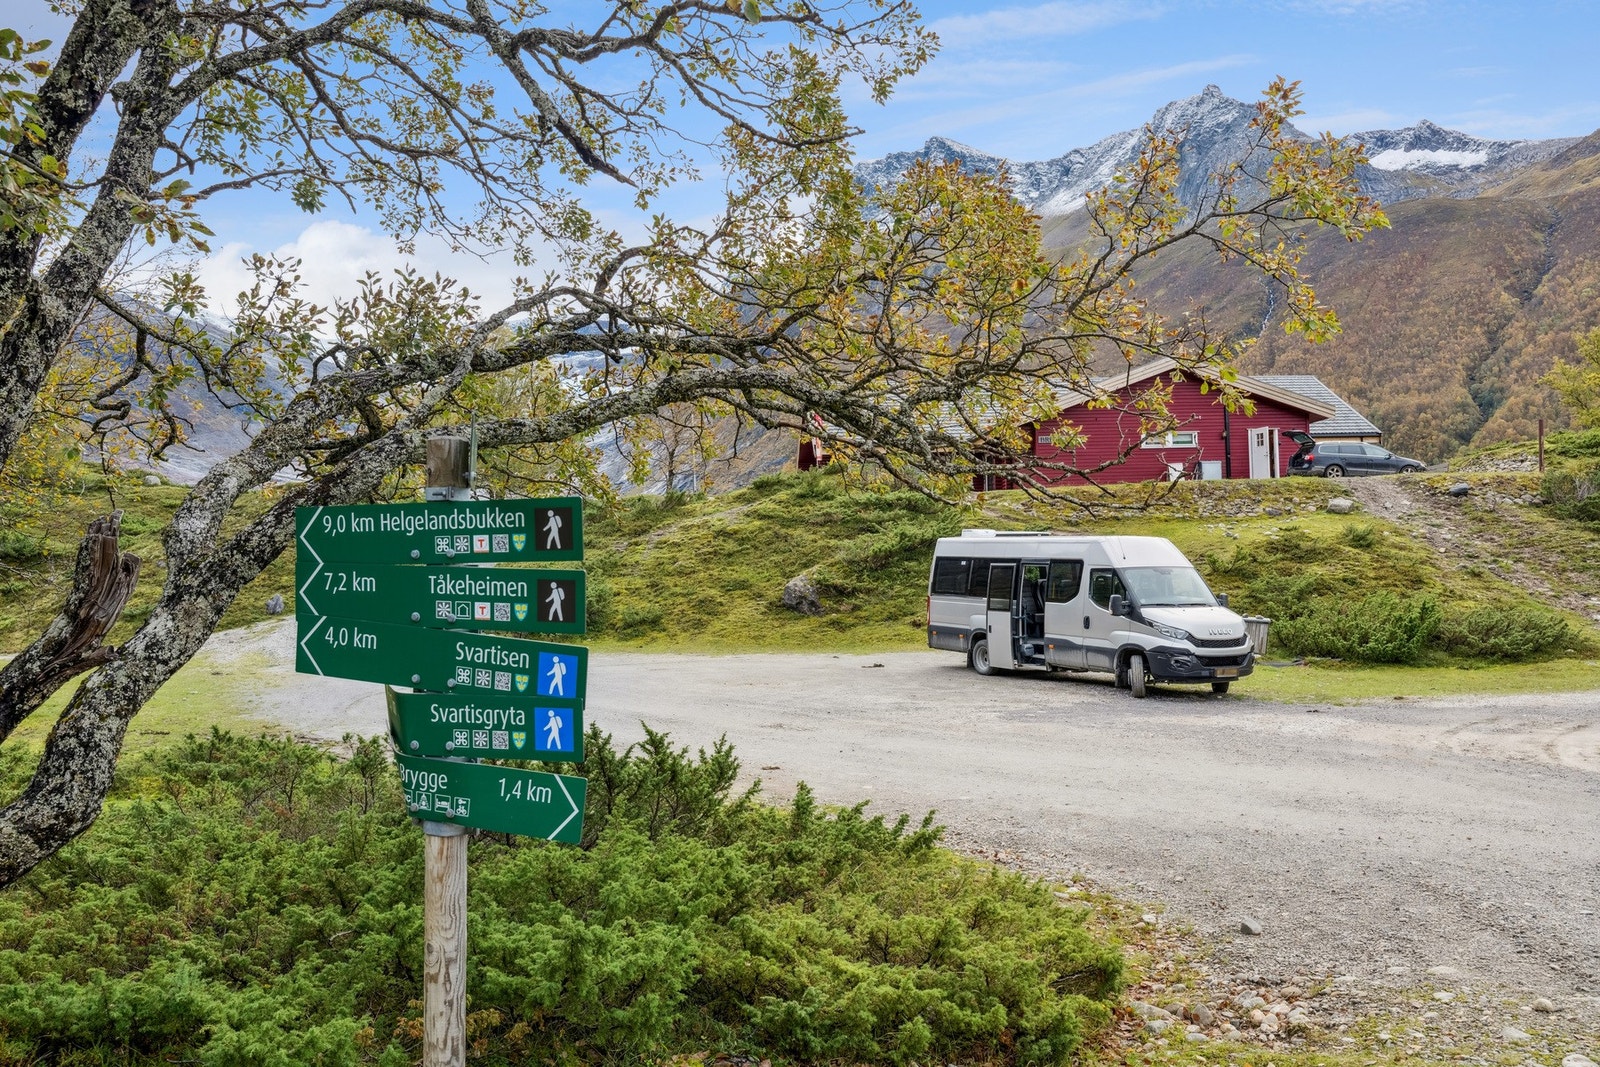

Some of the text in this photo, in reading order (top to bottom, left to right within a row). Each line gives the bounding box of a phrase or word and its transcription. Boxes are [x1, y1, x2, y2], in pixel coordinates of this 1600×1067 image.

[323, 507, 525, 536] 9,0 km Helgelandsbukken
[478, 539, 484, 548] T
[324, 571, 527, 597] 7,2 km Tåkeheimen
[479, 606, 486, 615] T
[325, 627, 529, 669] 4,0 km Svartisen
[431, 704, 525, 729] Svartisgryta
[400, 763, 552, 804] Brygge 1,4 km
